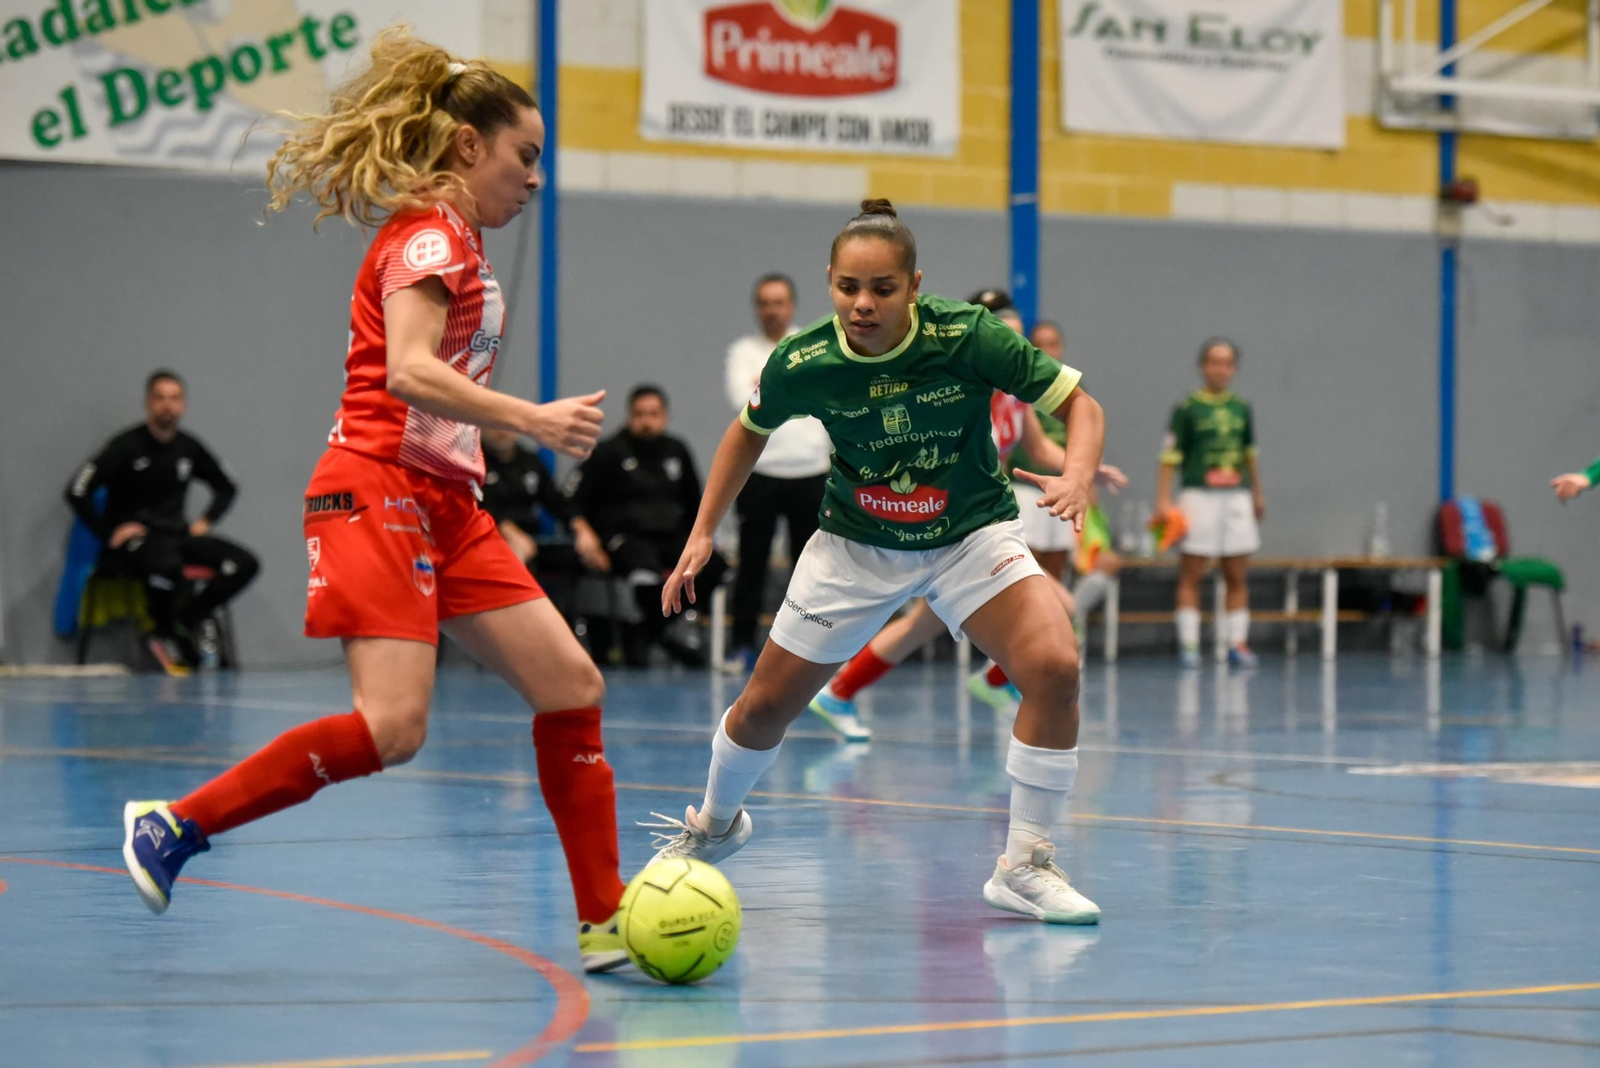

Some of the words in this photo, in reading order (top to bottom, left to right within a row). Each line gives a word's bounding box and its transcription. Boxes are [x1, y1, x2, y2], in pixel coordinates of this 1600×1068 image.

[710, 20, 895, 82] Primeale
[31, 85, 87, 147] el
[99, 13, 359, 127] Deporte
[916, 384, 961, 404] NACEX
[306, 492, 354, 513] RUCKS
[860, 492, 944, 514] Primeale
